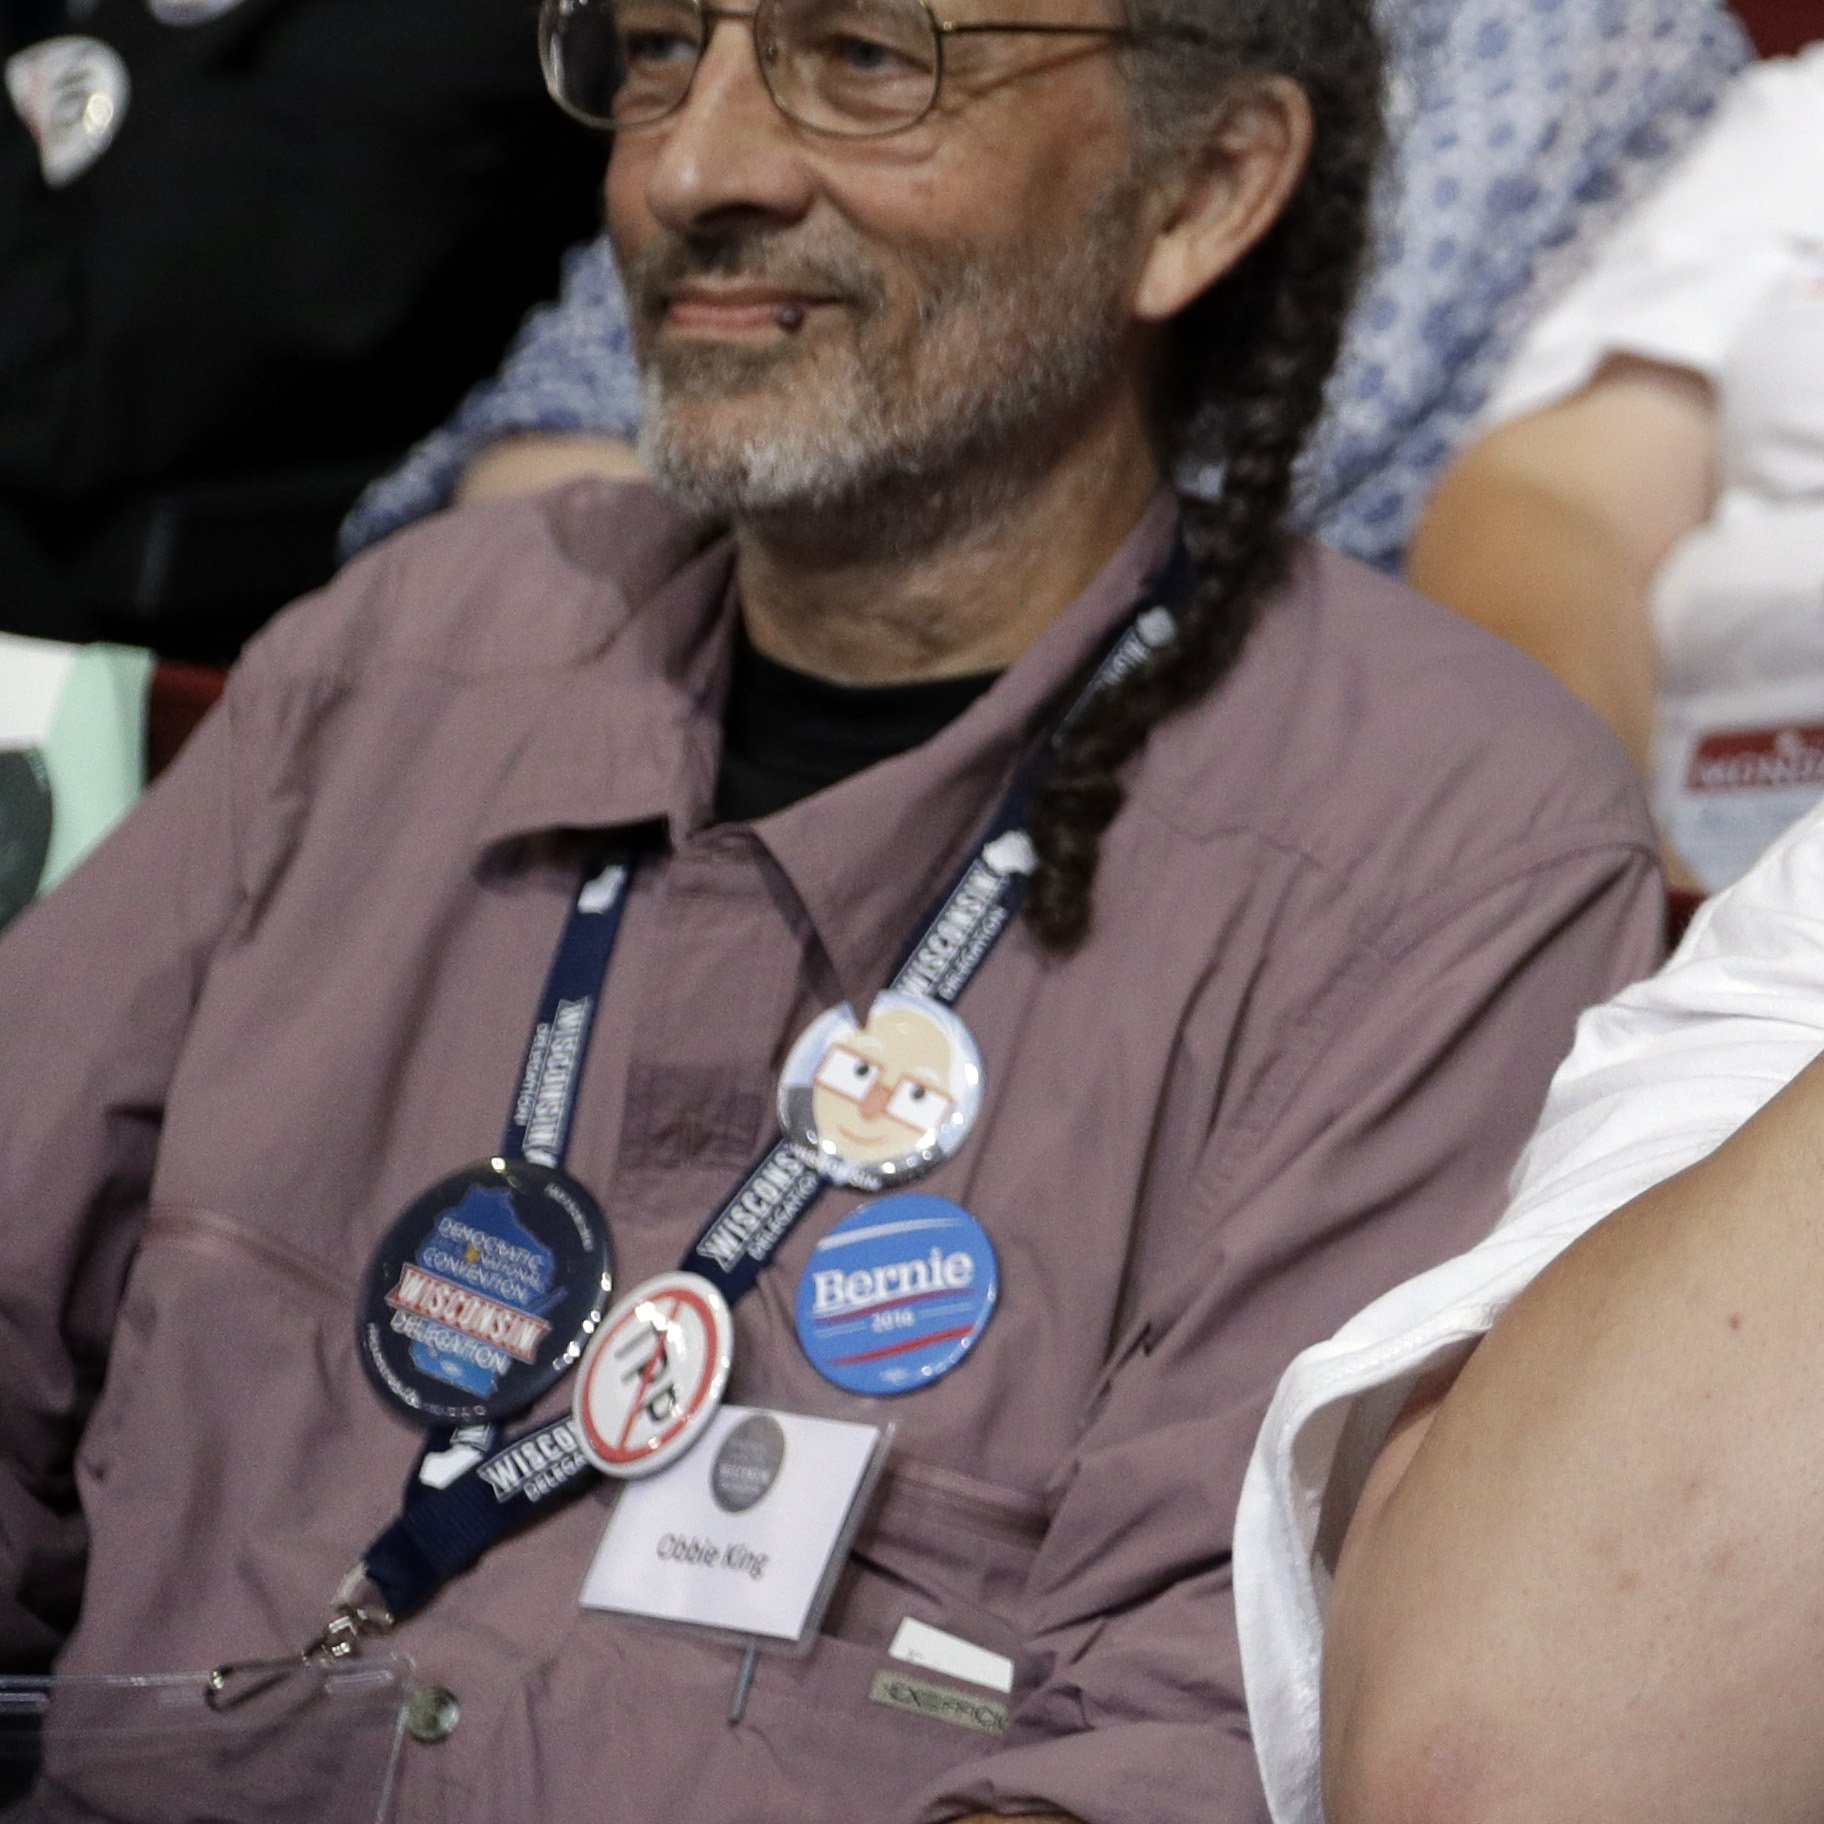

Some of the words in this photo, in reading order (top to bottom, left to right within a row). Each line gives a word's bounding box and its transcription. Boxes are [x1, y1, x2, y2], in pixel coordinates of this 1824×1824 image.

[398, 1270, 545, 1358] WISCONSIN
[812, 1247, 975, 1315] Bernie
[390, 1308, 511, 1376] DELEGATION
[719, 1540, 769, 1584] King
